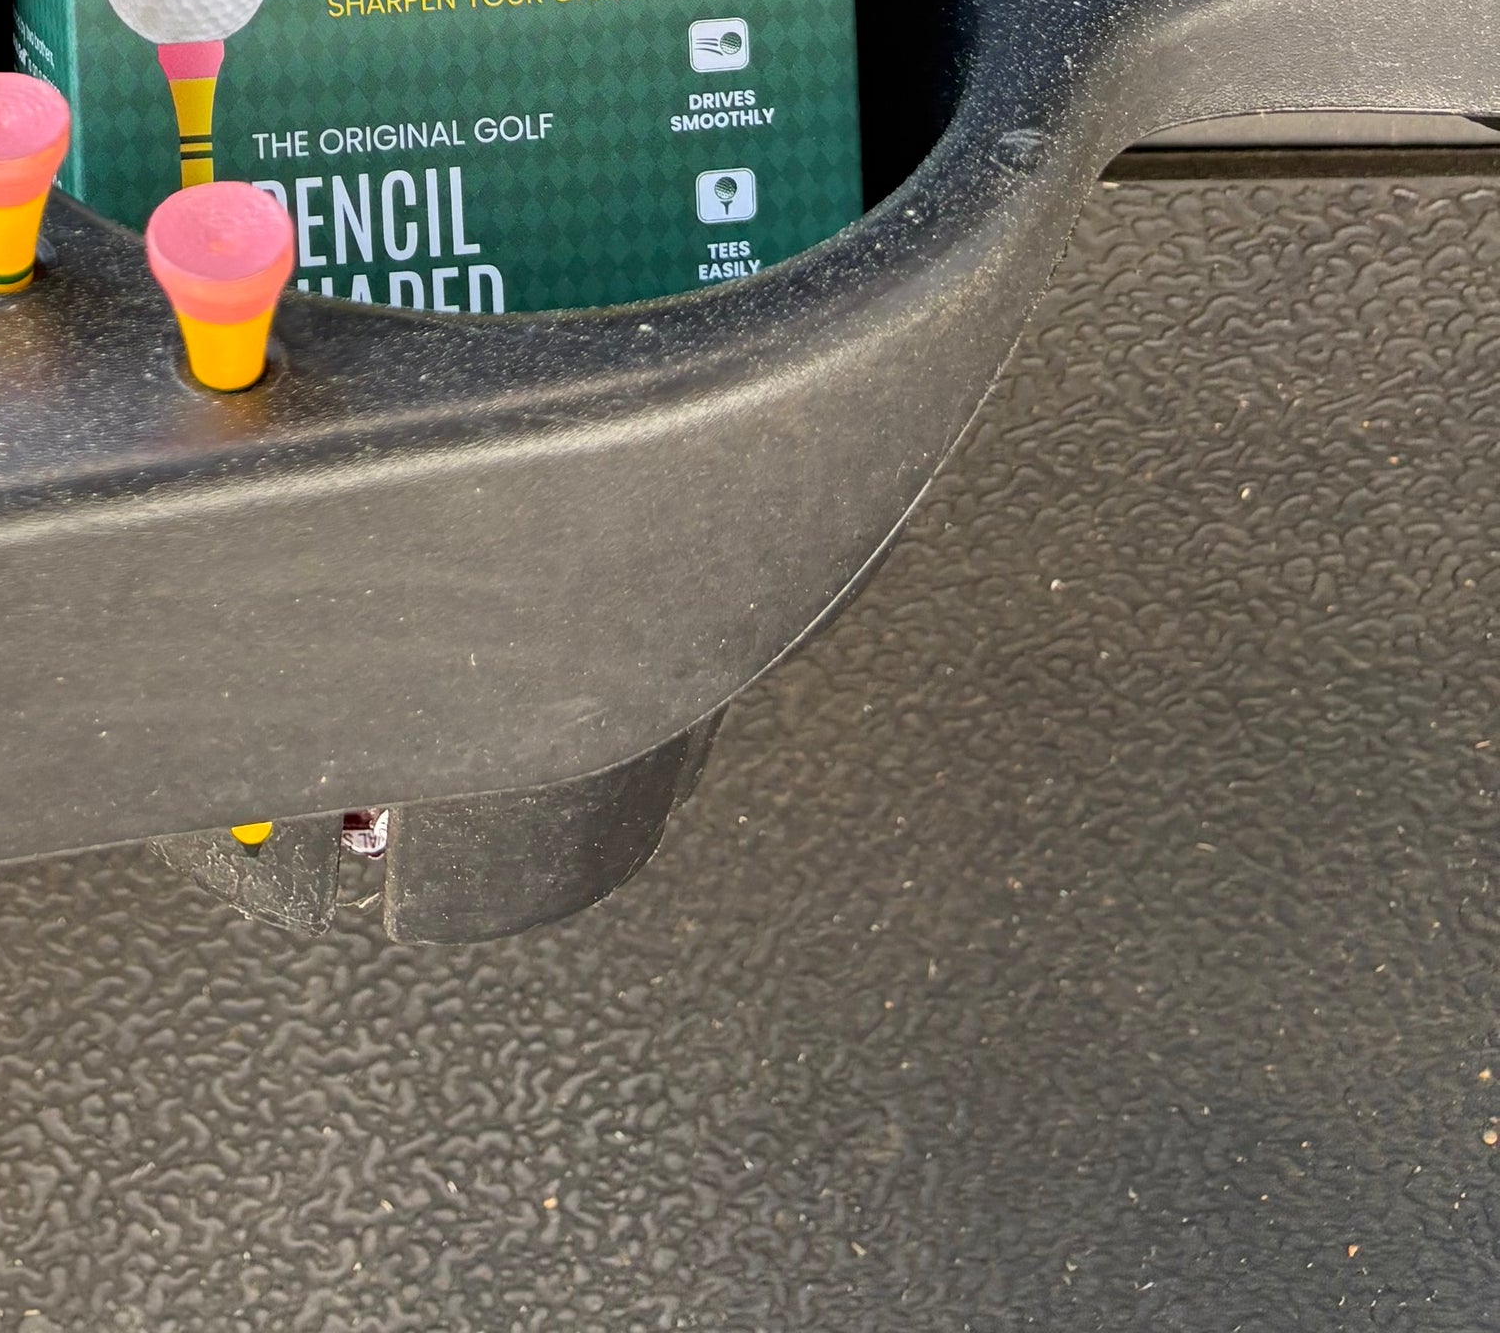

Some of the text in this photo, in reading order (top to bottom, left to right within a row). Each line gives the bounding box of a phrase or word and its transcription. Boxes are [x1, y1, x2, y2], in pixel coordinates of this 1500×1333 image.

[688, 89, 756, 111] DRIVES
[670, 107, 775, 132] SMOOTHLY
[252, 112, 554, 160] THE ORIGINAL GOLF
[707, 240, 751, 260] TEES
[698, 259, 761, 281] EASILY
